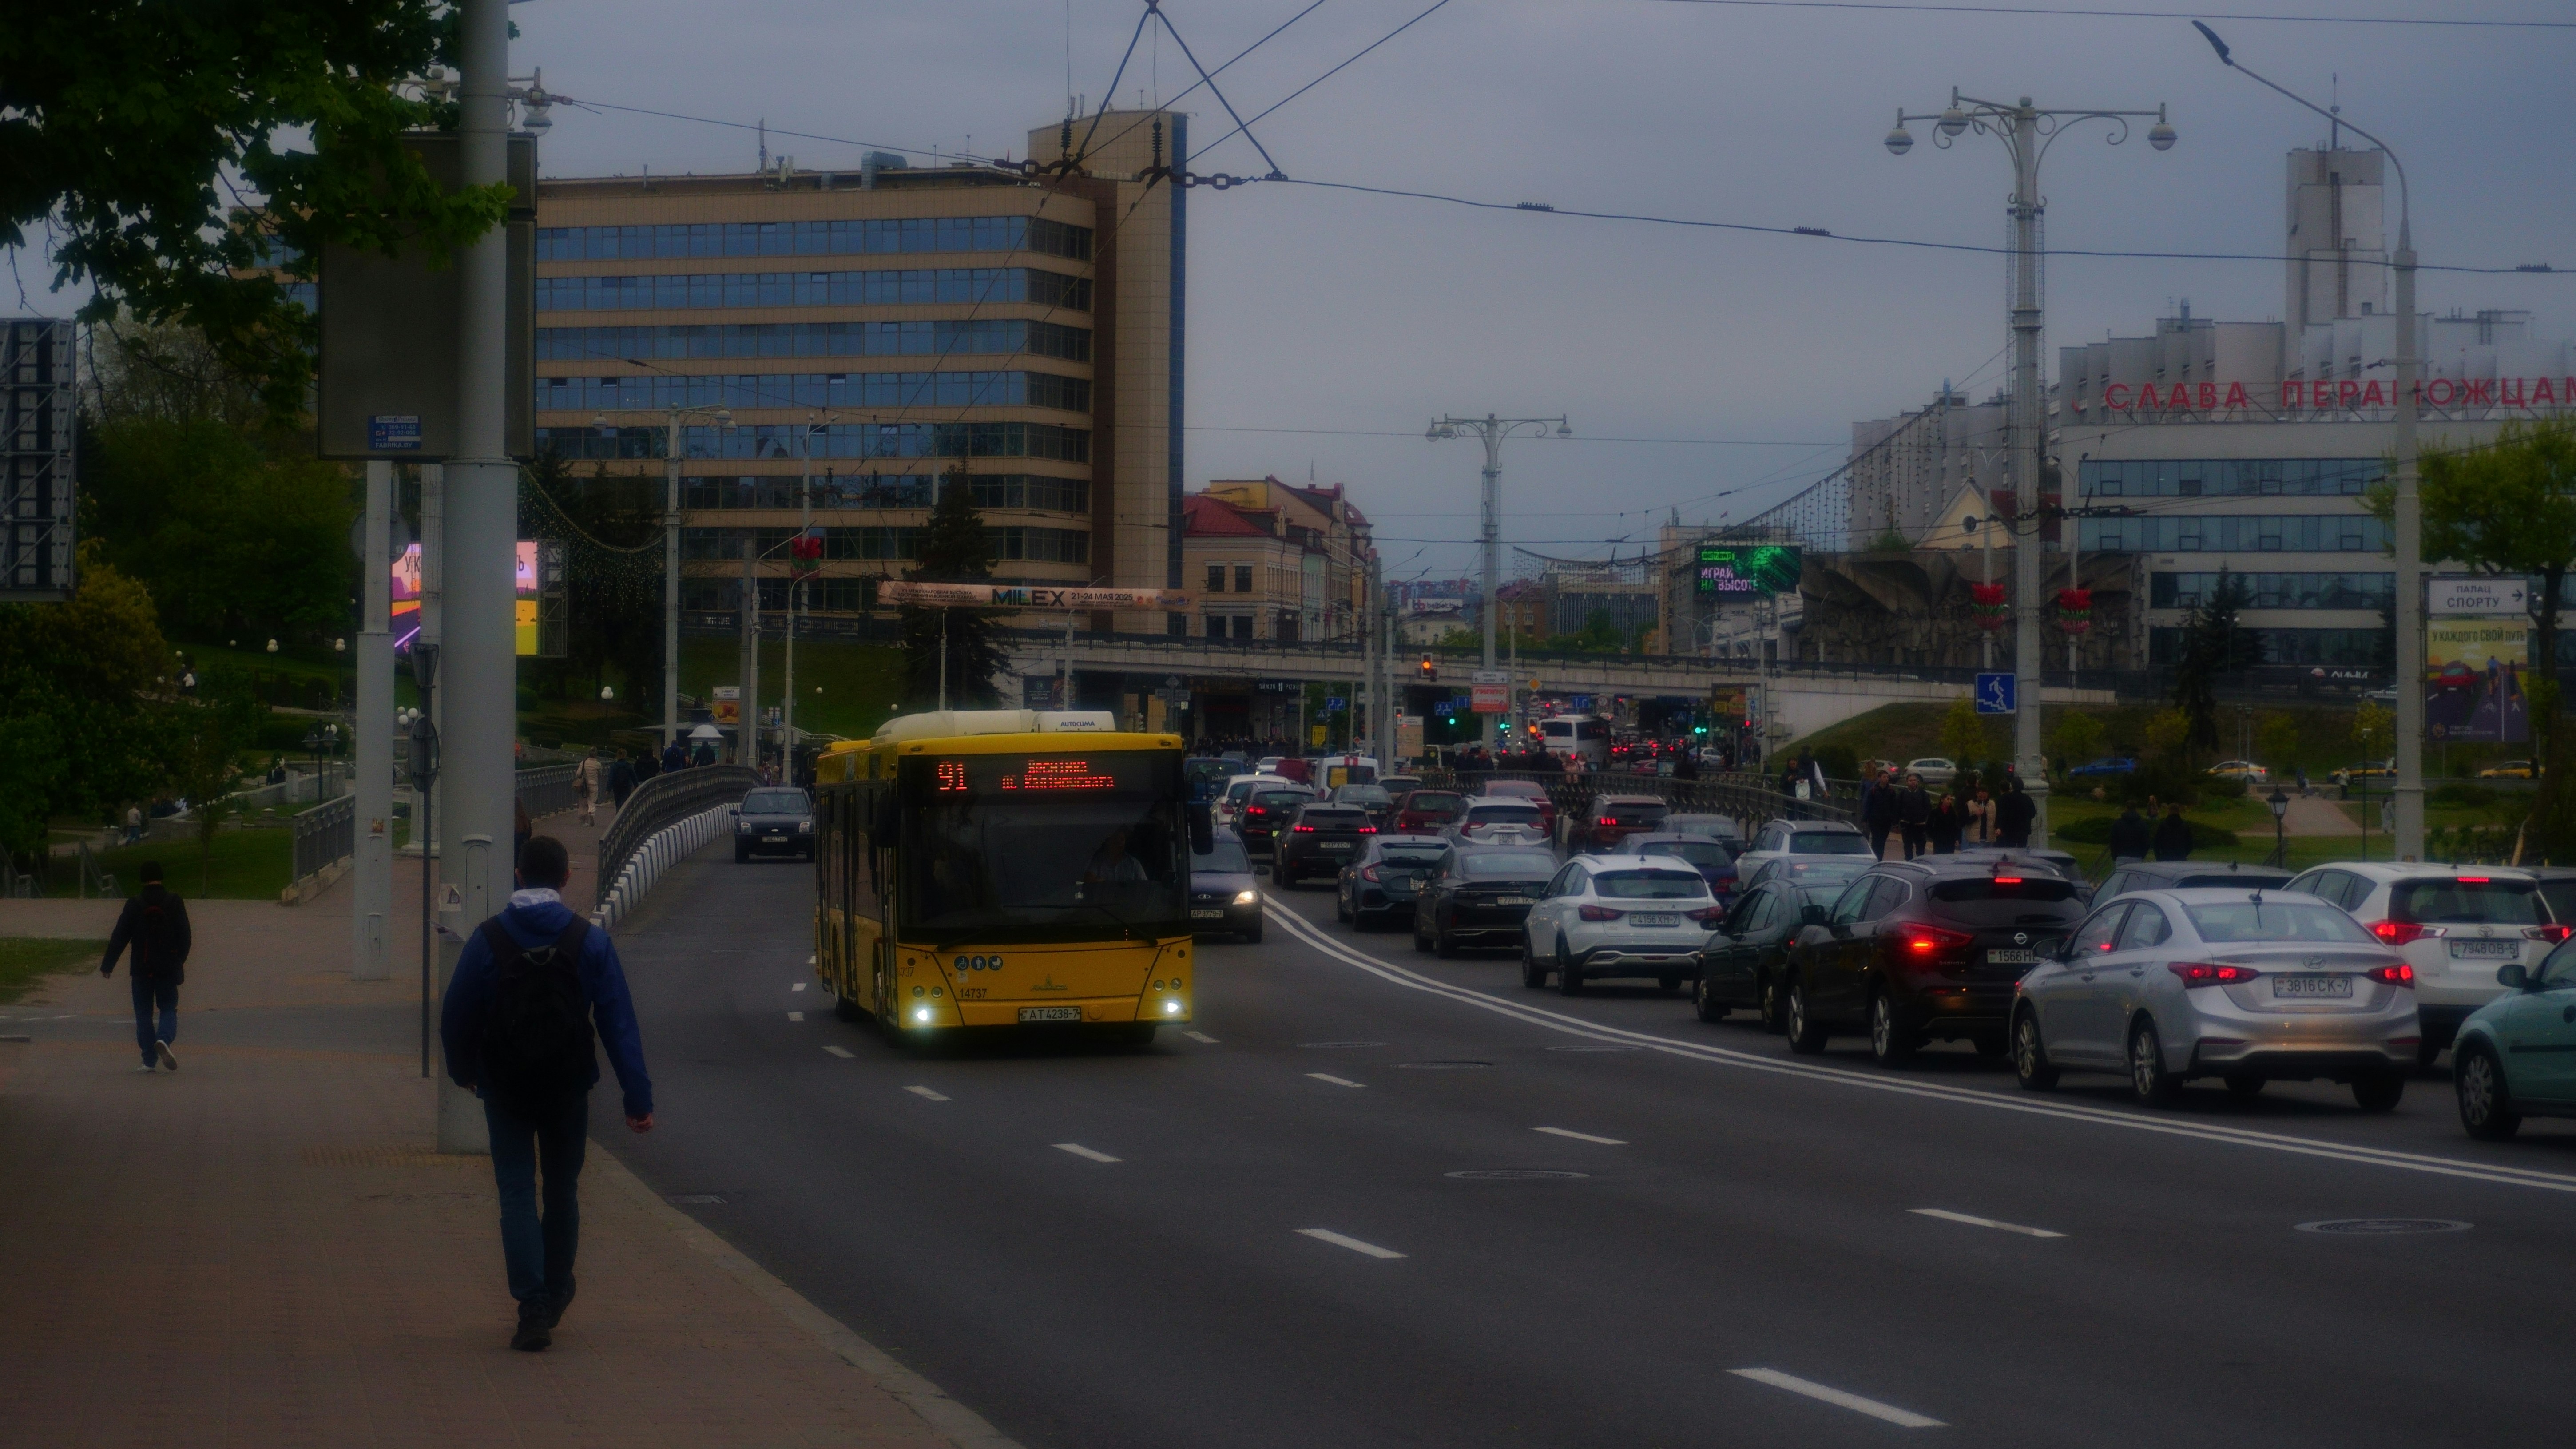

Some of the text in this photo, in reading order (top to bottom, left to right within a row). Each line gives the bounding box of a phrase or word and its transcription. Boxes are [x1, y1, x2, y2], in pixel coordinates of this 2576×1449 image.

[2104, 376, 2576, 411] СЛАВА ПЕРАОЖЦА
[1701, 567, 1734, 578] ИГРАЙ
[1701, 580, 1715, 590] НА
[992, 589, 1065, 607] MILEX
[2447, 597, 2500, 607] СПОРТУ
[2433, 627, 2525, 643] У КАЖДОГО СВОЙ ПУТЬ
[938, 760, 967, 790] 91
[2462, 943, 2515, 954] 7948 OB-5
[1998, 951, 2022, 961] 1566
[2286, 979, 2349, 992] 3816 CK-7
[960, 988, 987, 998] 14737
[1030, 1008, 1078, 1020] AT 4238-7
